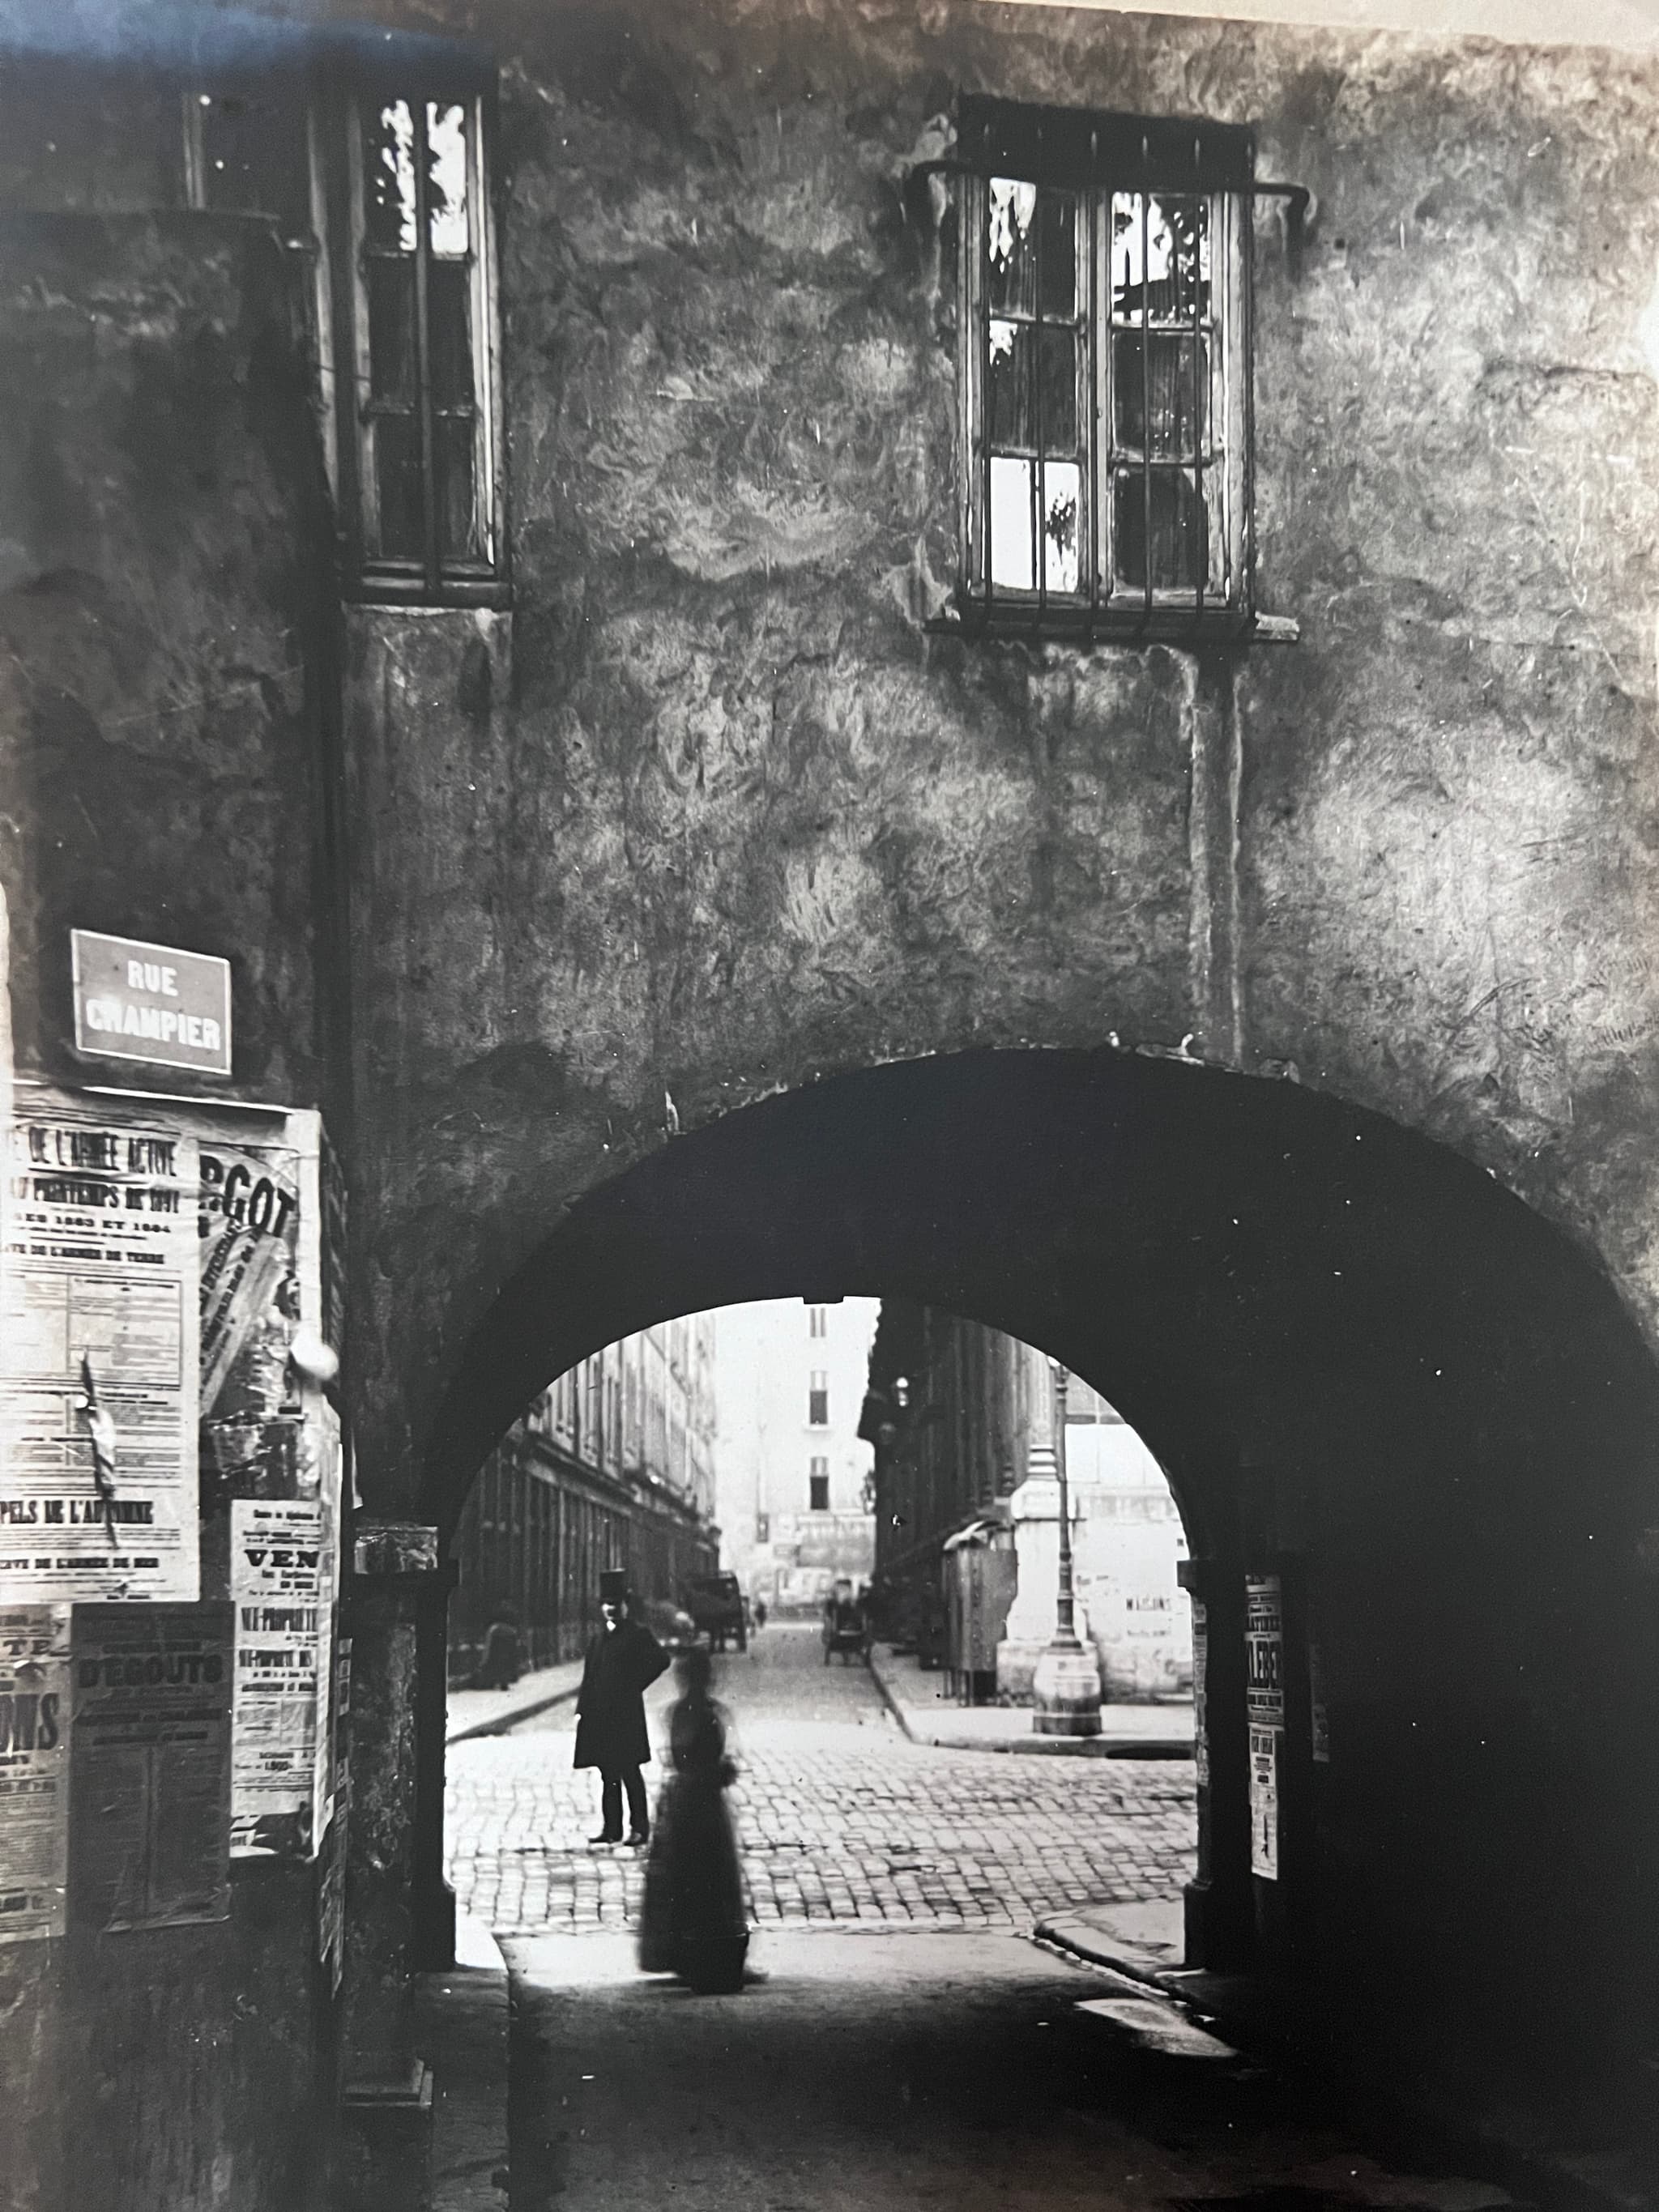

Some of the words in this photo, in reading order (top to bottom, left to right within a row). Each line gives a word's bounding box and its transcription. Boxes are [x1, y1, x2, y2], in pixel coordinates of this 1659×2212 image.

[128, 960, 178, 996] RUE
[86, 999, 220, 1051] CHAMPIER
[102, 1220, 126, 1230] ET
[244, 1549, 320, 1568] VEN
